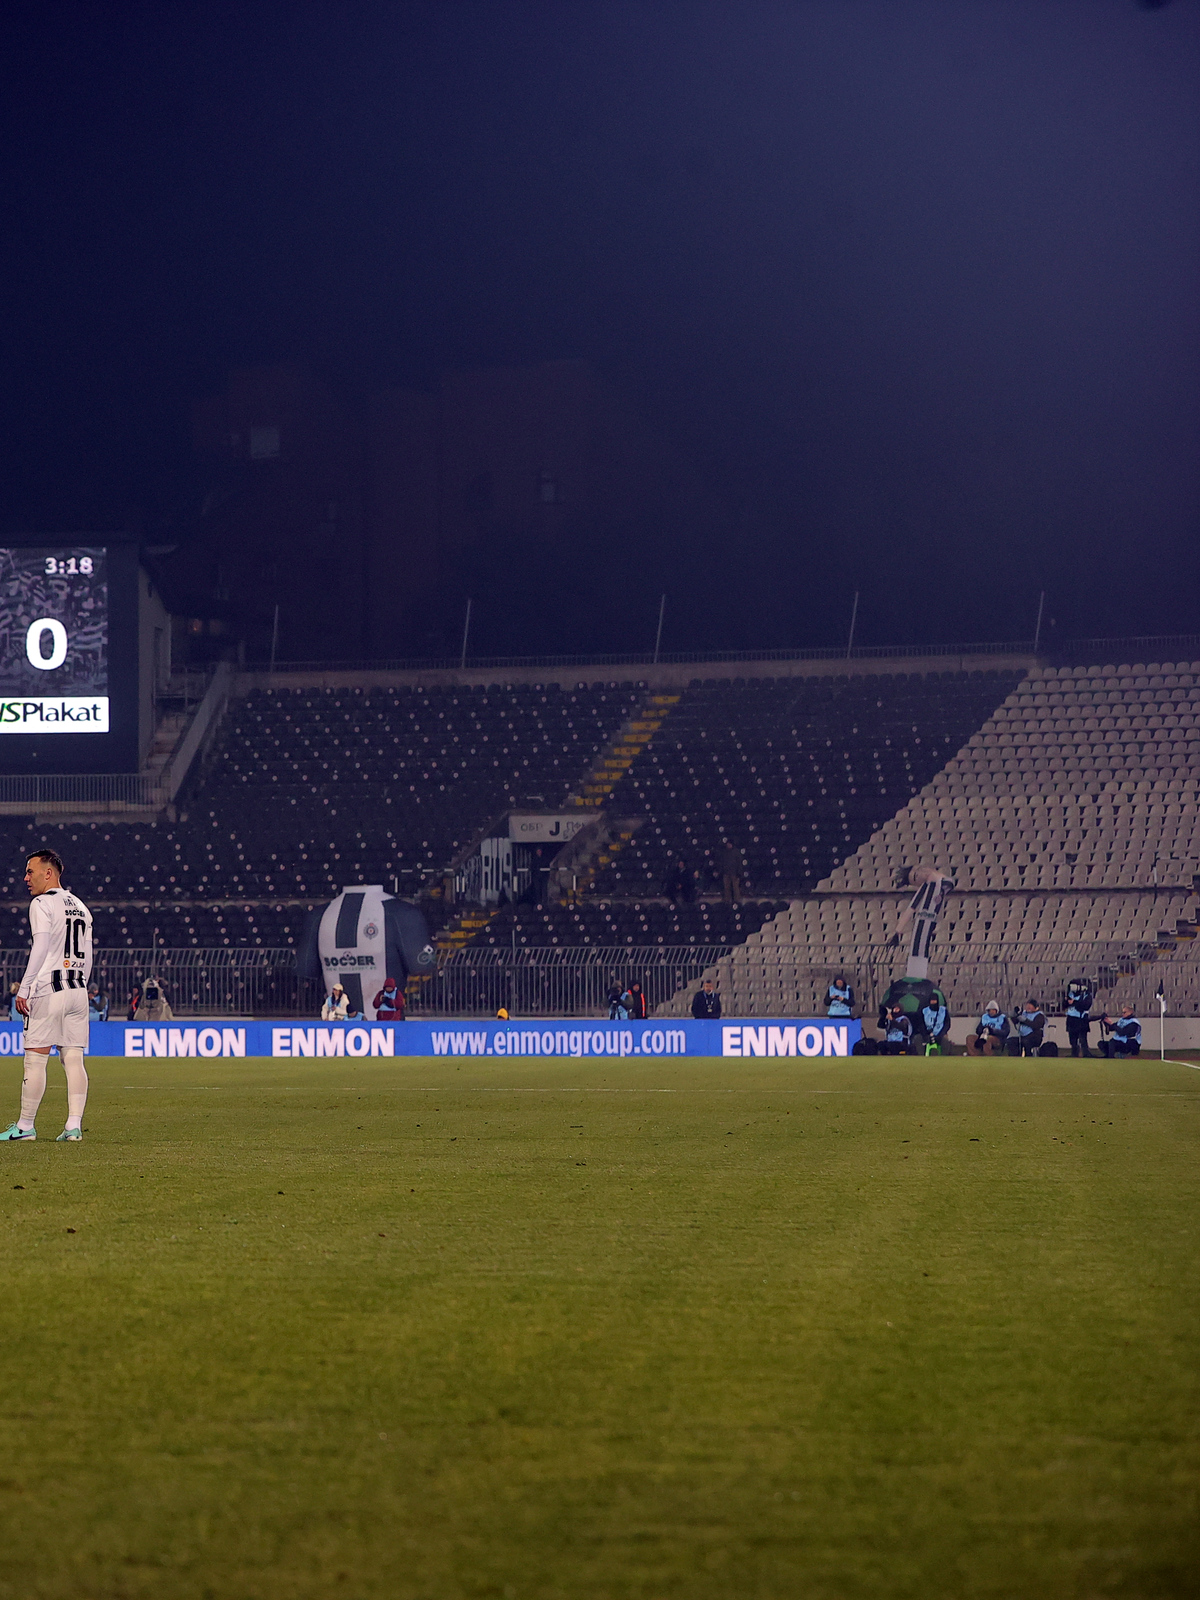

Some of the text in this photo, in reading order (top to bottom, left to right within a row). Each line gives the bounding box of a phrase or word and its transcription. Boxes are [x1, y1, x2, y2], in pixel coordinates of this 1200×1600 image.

[44, 557, 93, 575] 3:18
[25, 617, 68, 670] 0
[549, 821, 561, 837] J
[124, 1028, 395, 1057] ENMON ENMON
[431, 1029, 686, 1057] www.enmongroup.com
[722, 1026, 848, 1057] ENMON
